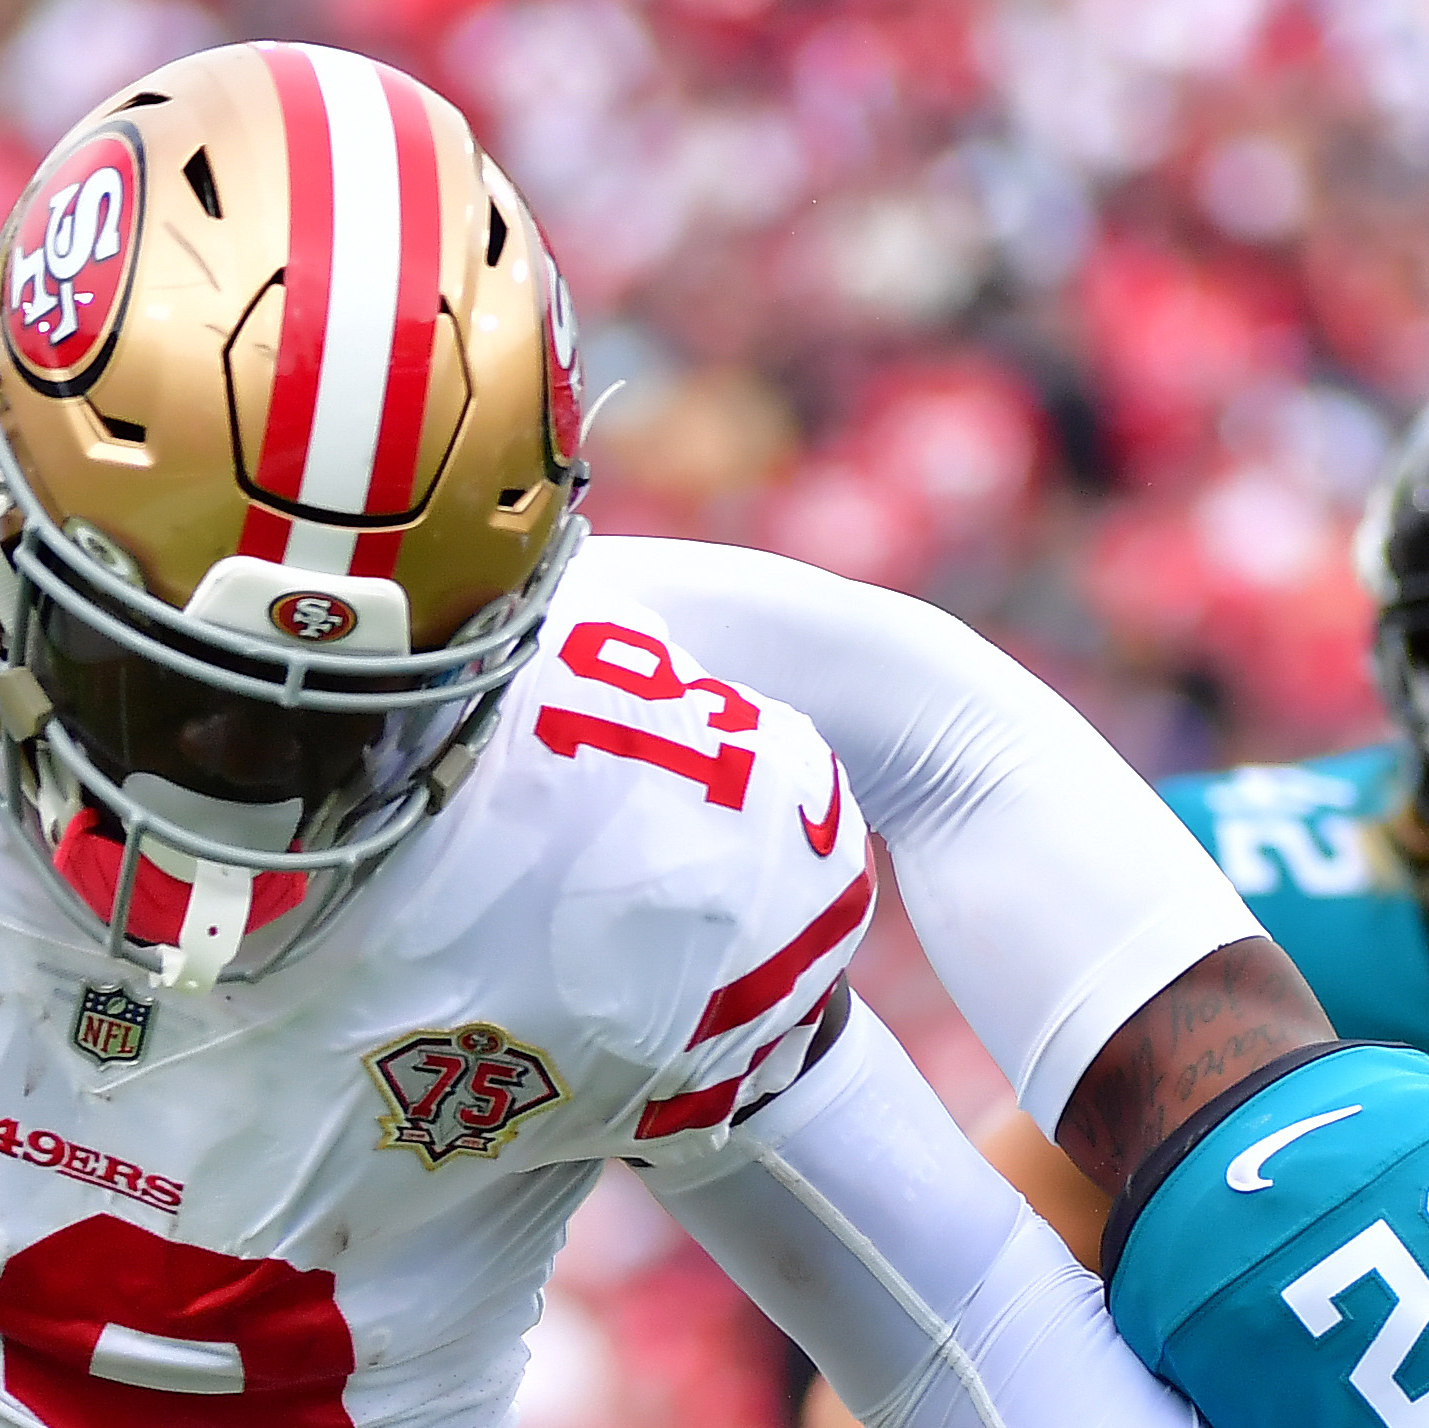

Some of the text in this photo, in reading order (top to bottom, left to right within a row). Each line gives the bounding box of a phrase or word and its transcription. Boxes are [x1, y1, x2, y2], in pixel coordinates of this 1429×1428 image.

[534, 621, 760, 812] 19
[80, 1015, 140, 1054] NFL
[409, 1053, 518, 1127] 75
